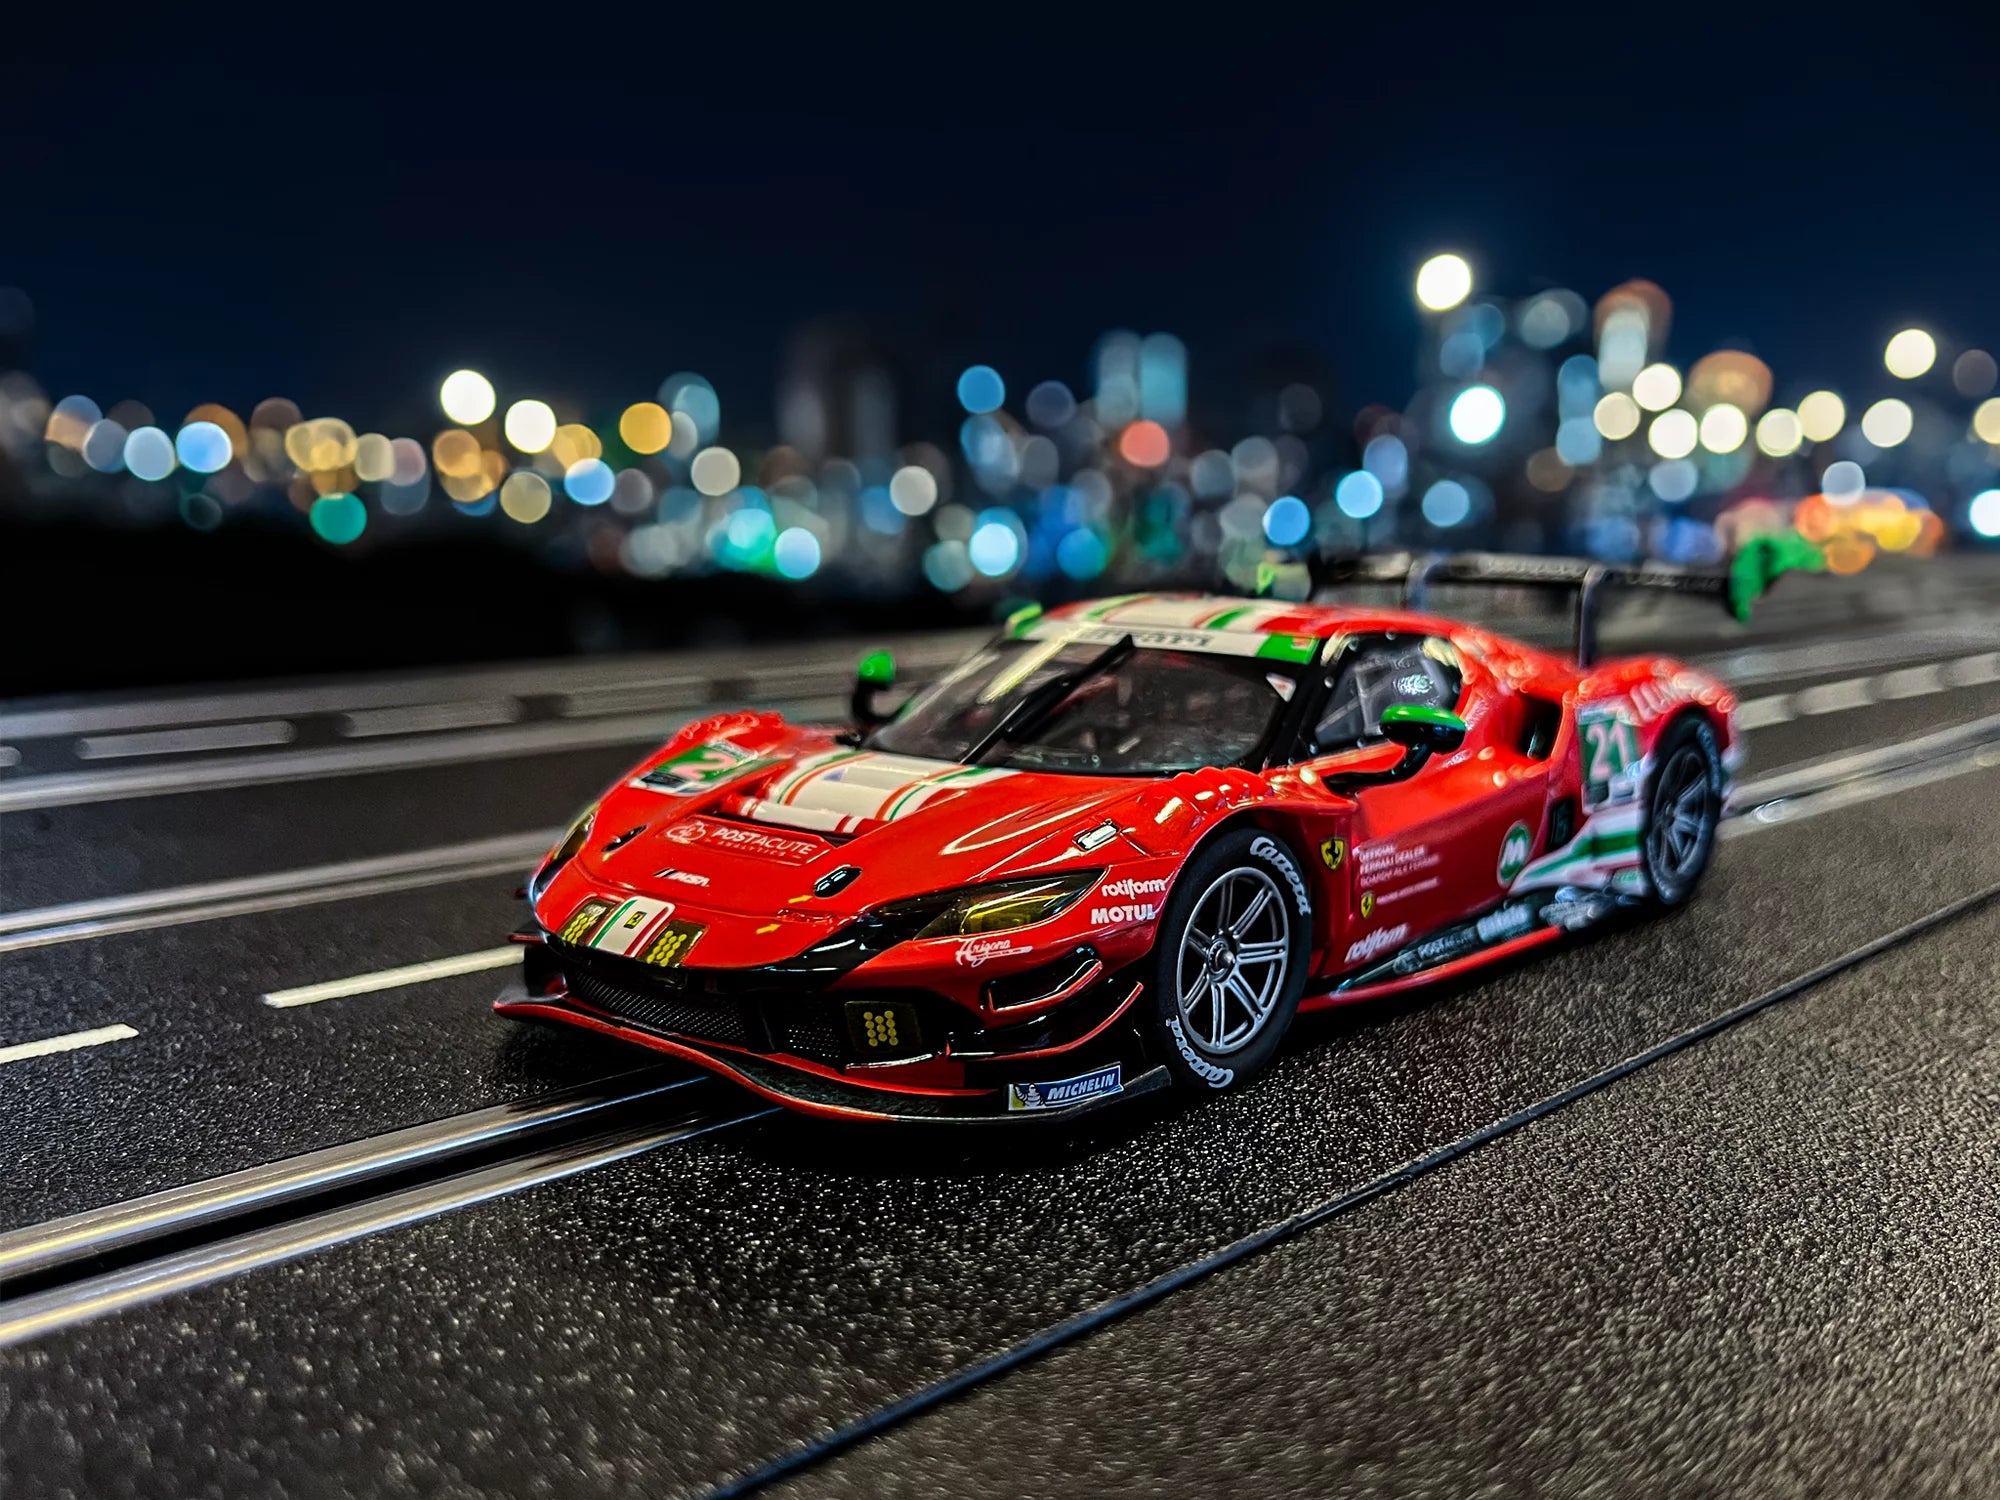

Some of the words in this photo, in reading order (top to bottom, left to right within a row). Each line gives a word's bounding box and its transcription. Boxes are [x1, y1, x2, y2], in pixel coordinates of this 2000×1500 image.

[1586, 721, 1631, 781] 21
[712, 827, 818, 856] POSTACUTE
[718, 840, 787, 857] ANALYTICS
[1360, 844, 1394, 863] OFFICIAL
[1101, 878, 1166, 900] rotiform
[1250, 836, 1312, 917] Carrera
[1091, 904, 1155, 924] MOTUL
[1166, 1015, 1234, 1089] Carrera
[1048, 1073, 1115, 1100] MICHELIN
